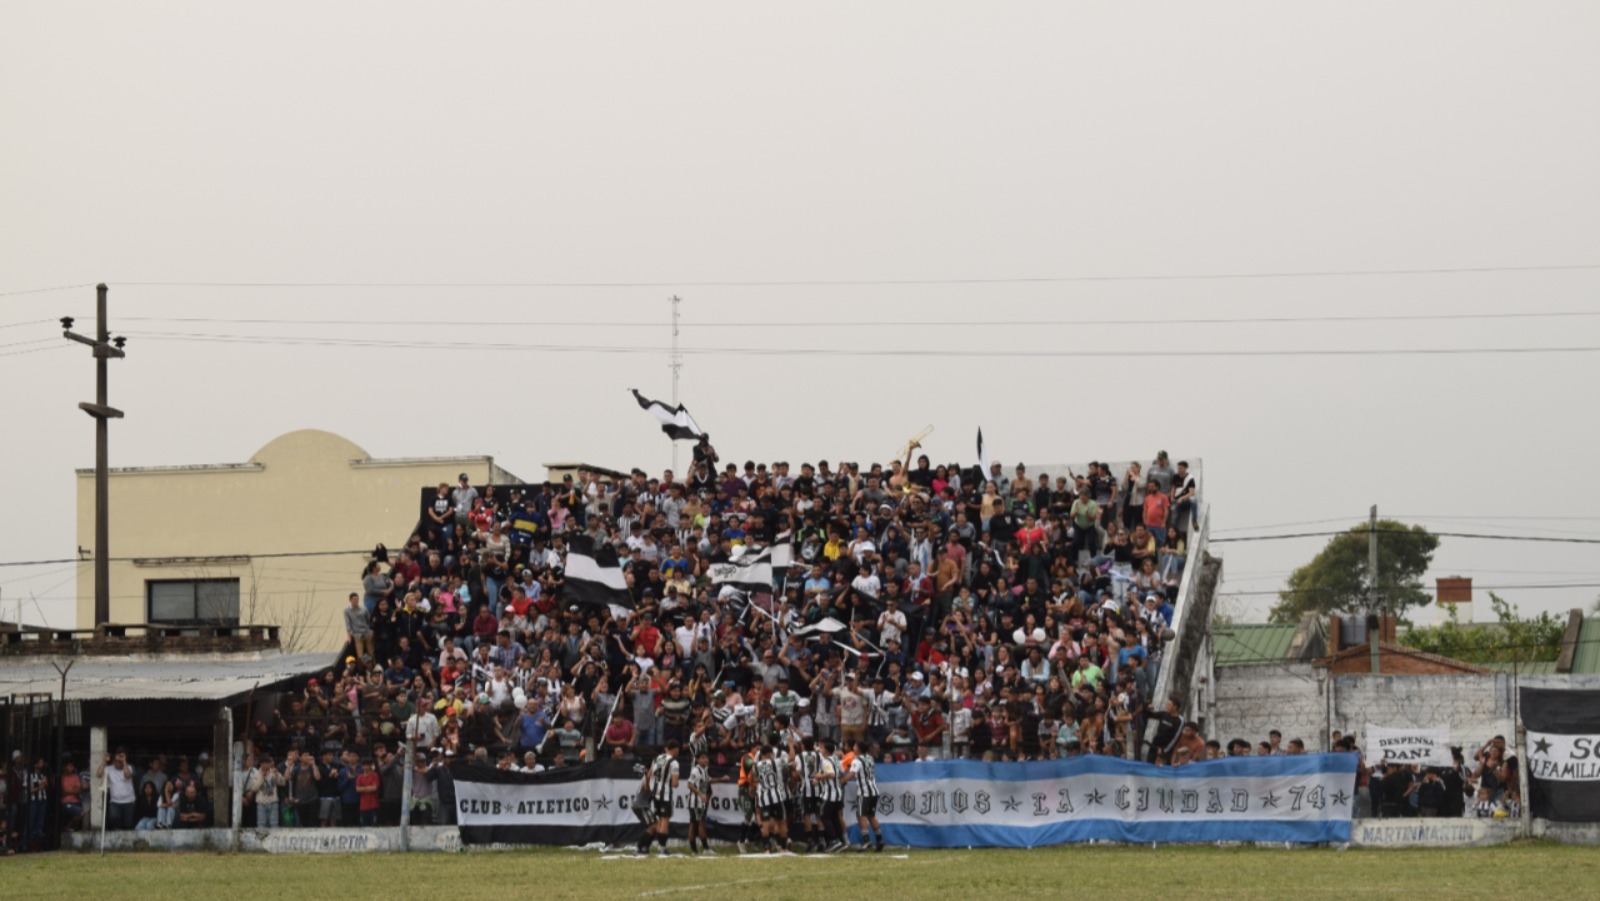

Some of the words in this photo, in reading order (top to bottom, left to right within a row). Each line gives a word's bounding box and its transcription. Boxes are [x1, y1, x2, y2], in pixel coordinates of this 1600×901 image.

[1379, 736, 1434, 748] DESPENSA
[1570, 737, 1600, 760] S
[1383, 748, 1431, 760] DANI
[459, 798, 502, 815] CLUB
[517, 796, 590, 815] ATLETICO
[711, 795, 740, 812] GOY
[877, 787, 991, 816] SOMOS
[1031, 788, 1074, 816] LA
[1288, 784, 1326, 811] 74
